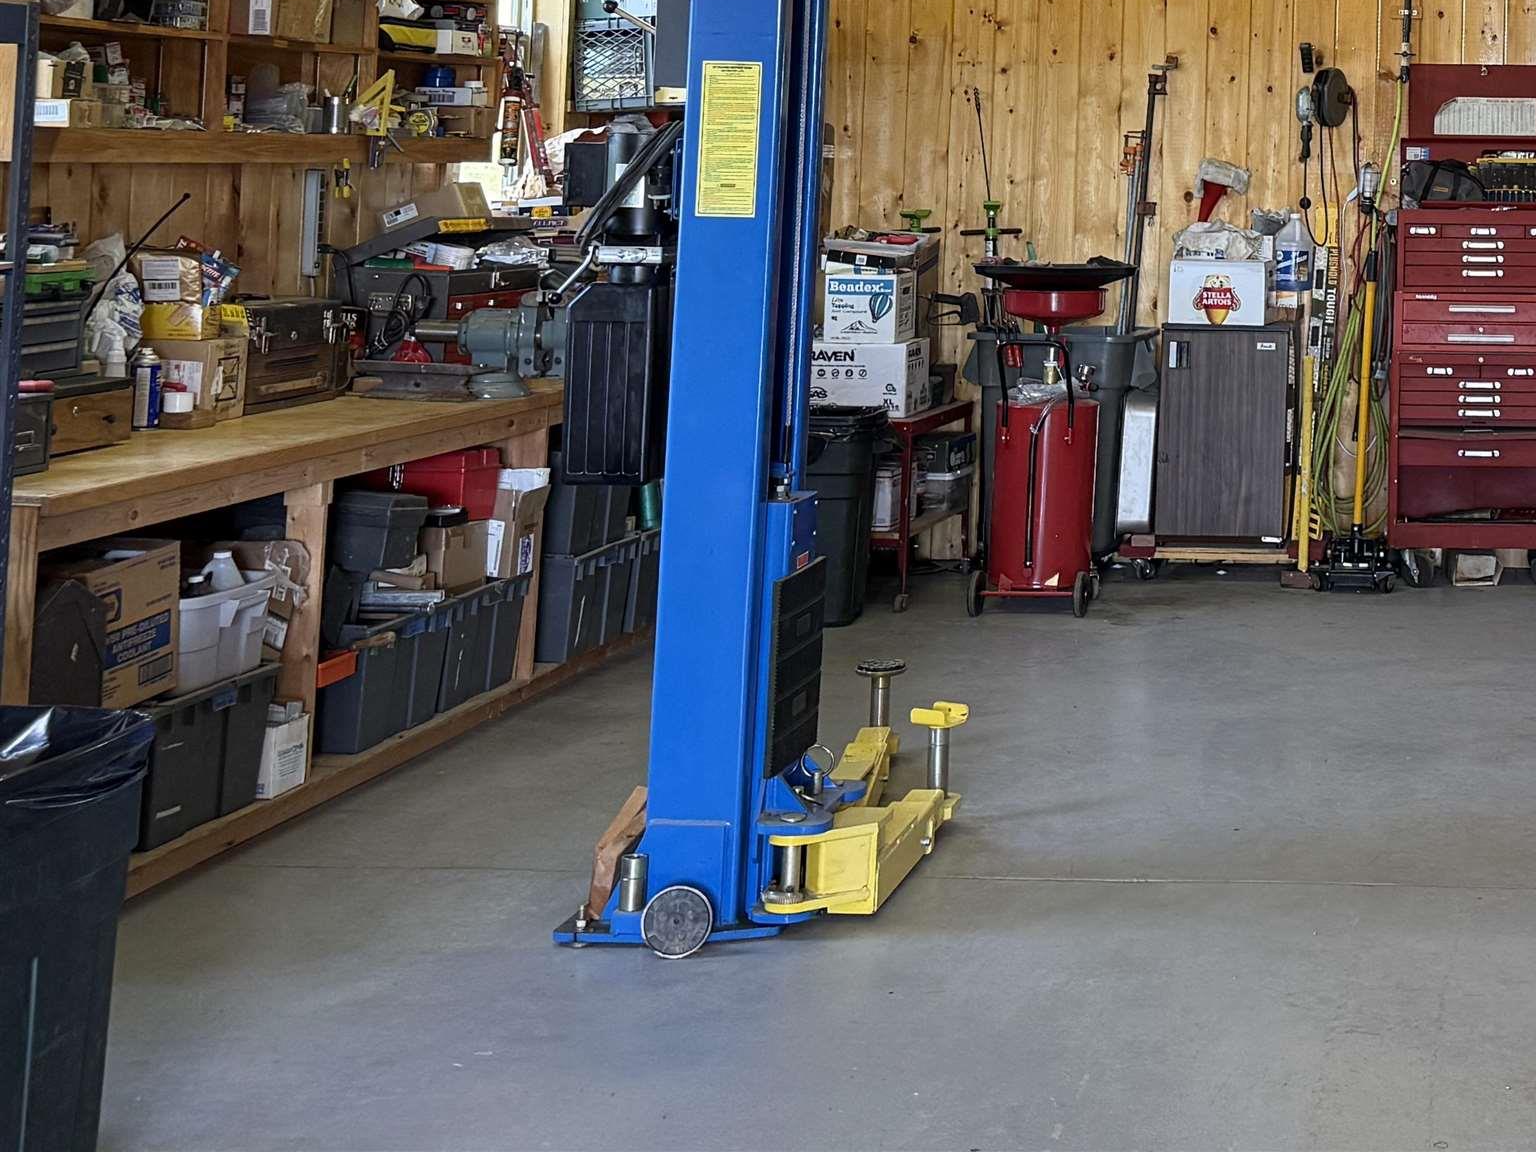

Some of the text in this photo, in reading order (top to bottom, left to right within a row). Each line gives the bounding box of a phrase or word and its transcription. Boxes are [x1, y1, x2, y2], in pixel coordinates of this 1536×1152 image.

[1202, 291, 1231, 299] STELLA
[1201, 298, 1232, 306] ARTOIS
[1325, 287, 1337, 324] TOUGH
